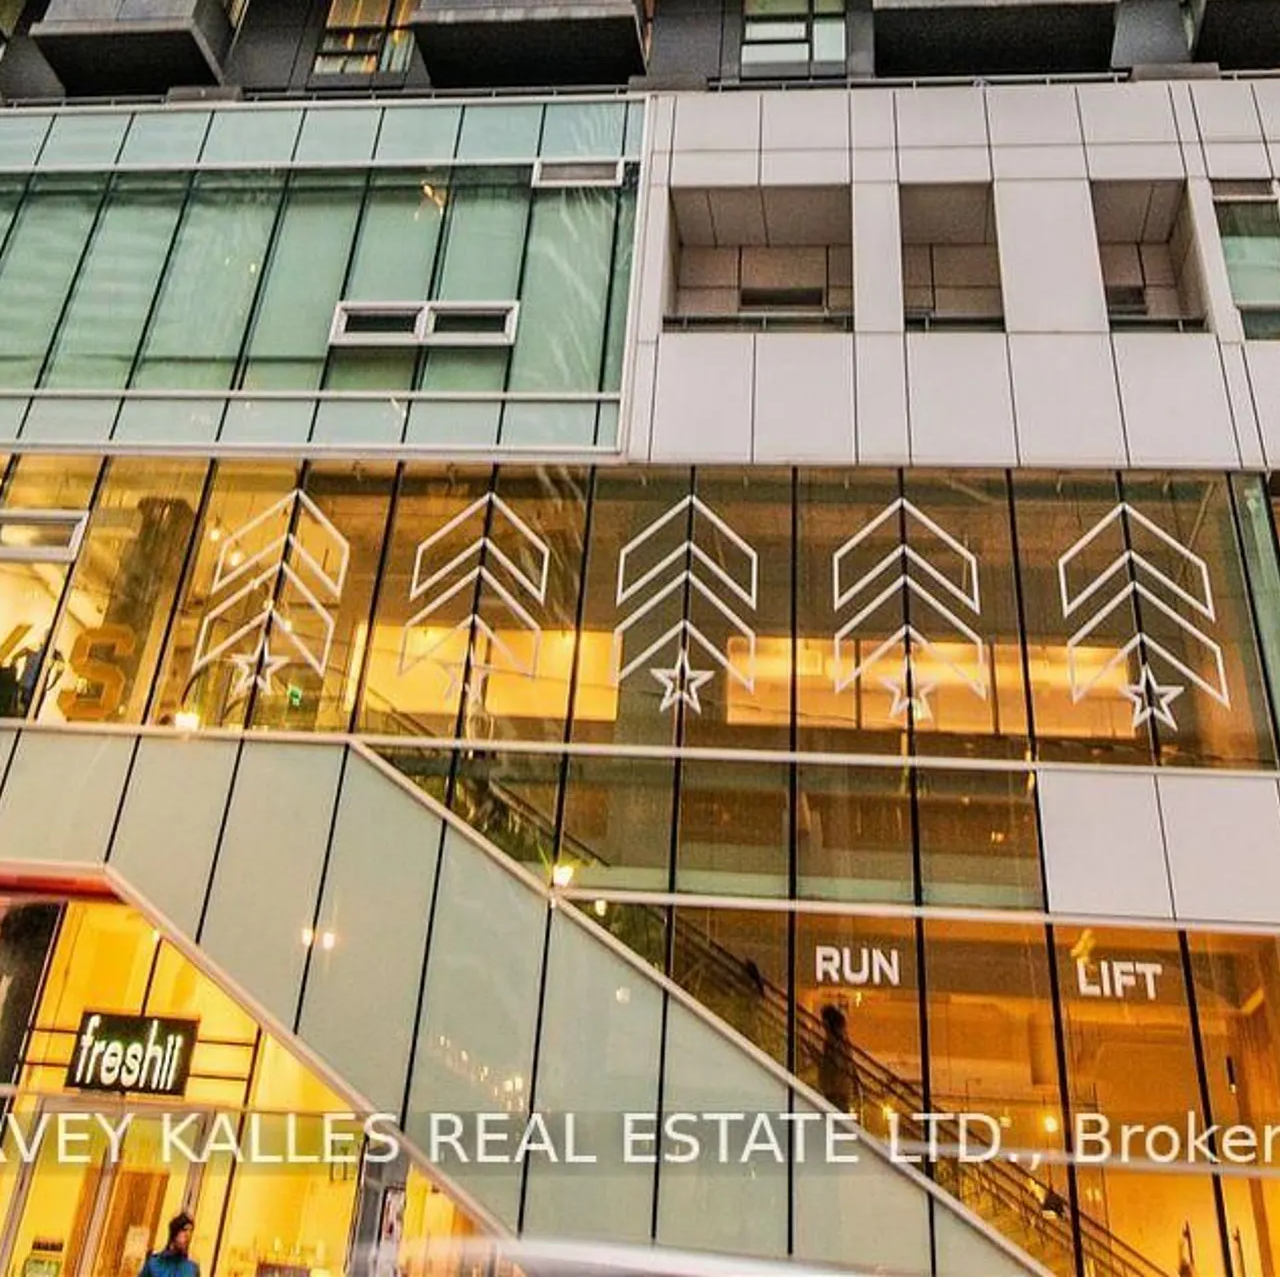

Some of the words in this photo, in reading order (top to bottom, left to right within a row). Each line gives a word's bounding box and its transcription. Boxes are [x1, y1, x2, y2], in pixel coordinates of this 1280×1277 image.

[815, 946, 900, 986] RUN
[1076, 959, 1163, 1000] LIFT
[76, 1014, 181, 1092] freshii
